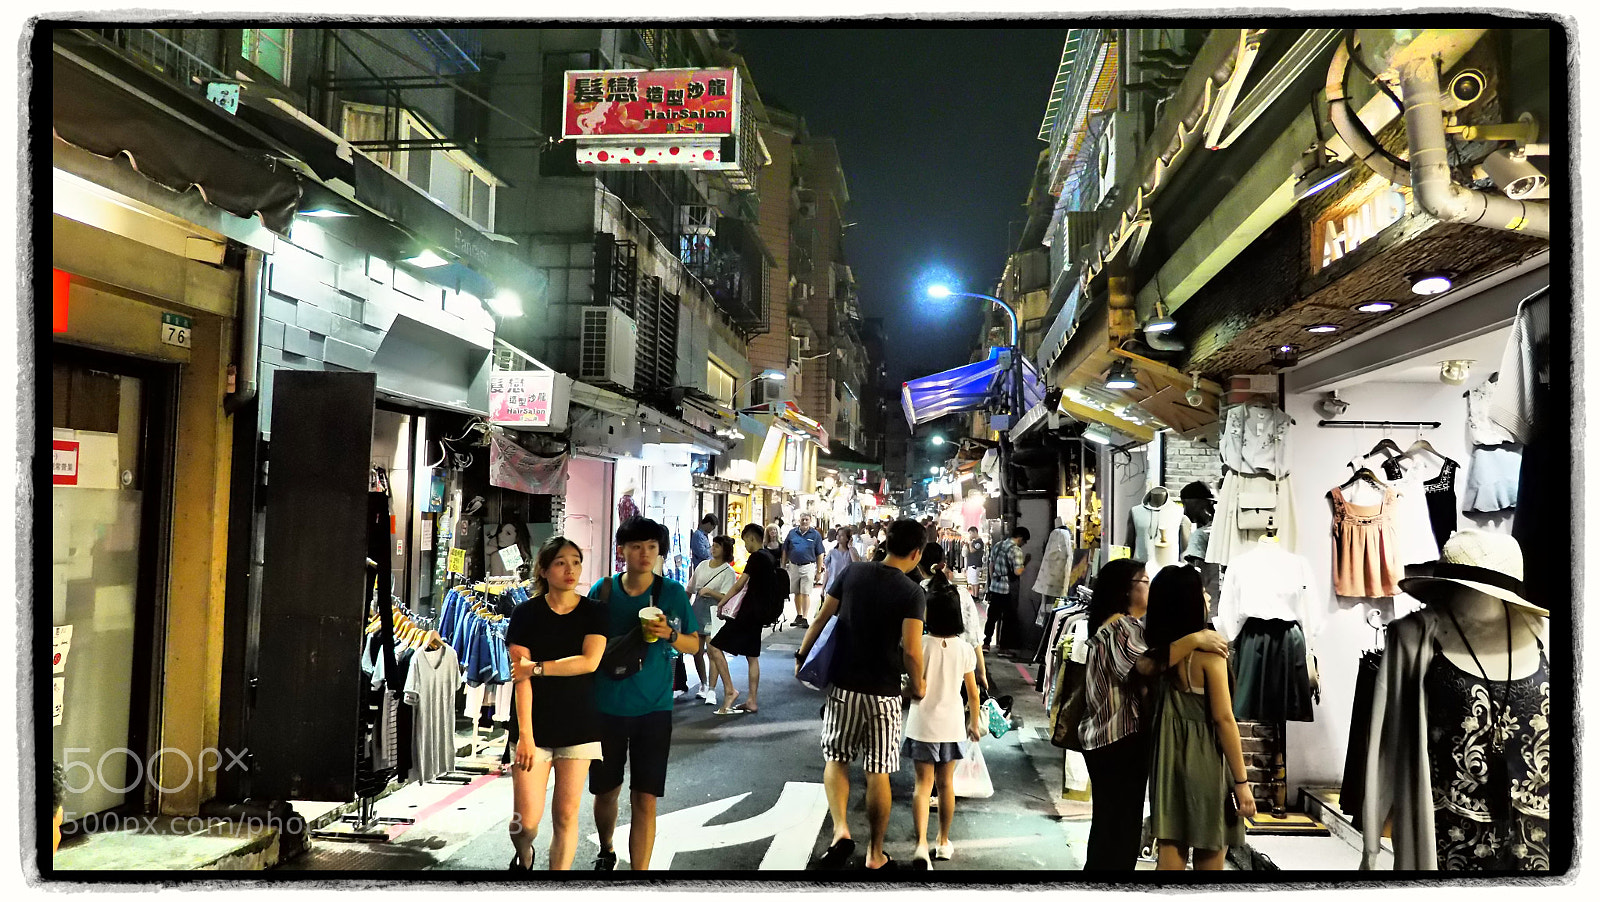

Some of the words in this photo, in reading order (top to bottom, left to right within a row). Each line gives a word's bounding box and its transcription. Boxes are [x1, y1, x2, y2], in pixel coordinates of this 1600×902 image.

[574, 76, 638, 103] 髮戀
[646, 78, 727, 106] 造型沙龍
[644, 108, 726, 119] HairSalon
[168, 327, 185, 344] 76
